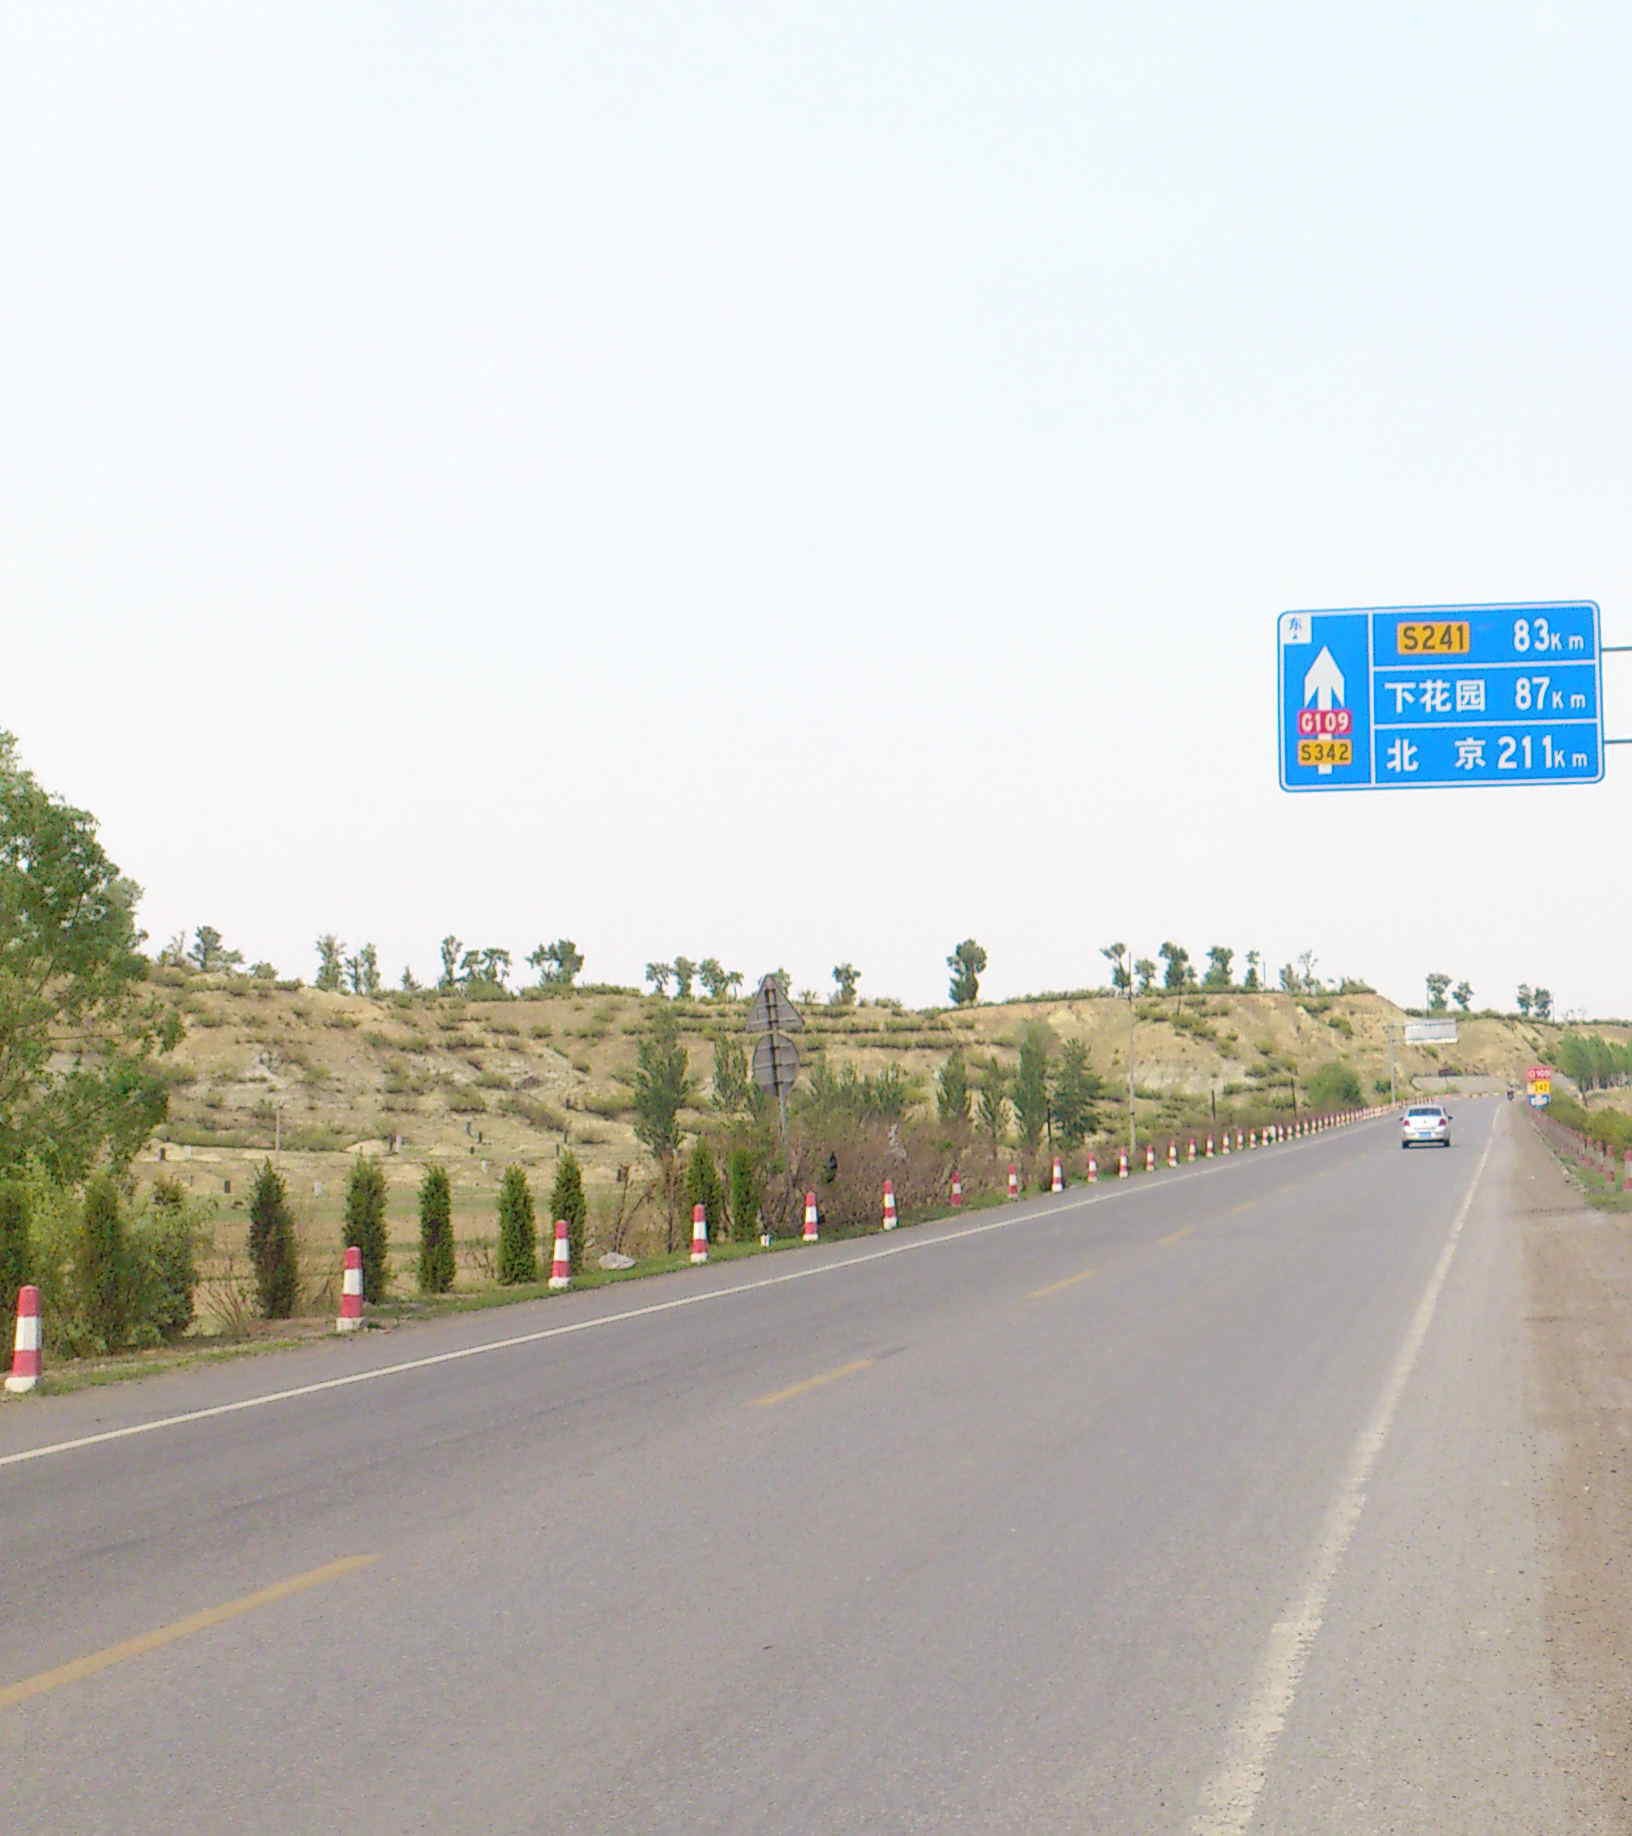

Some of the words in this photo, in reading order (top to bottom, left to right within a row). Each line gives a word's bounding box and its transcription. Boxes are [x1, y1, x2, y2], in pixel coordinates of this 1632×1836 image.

[1403, 624, 1464, 651] S241
[1384, 679, 1486, 713] 下花园
[1301, 711, 1349, 732] G109
[1301, 743, 1349, 761] S342
